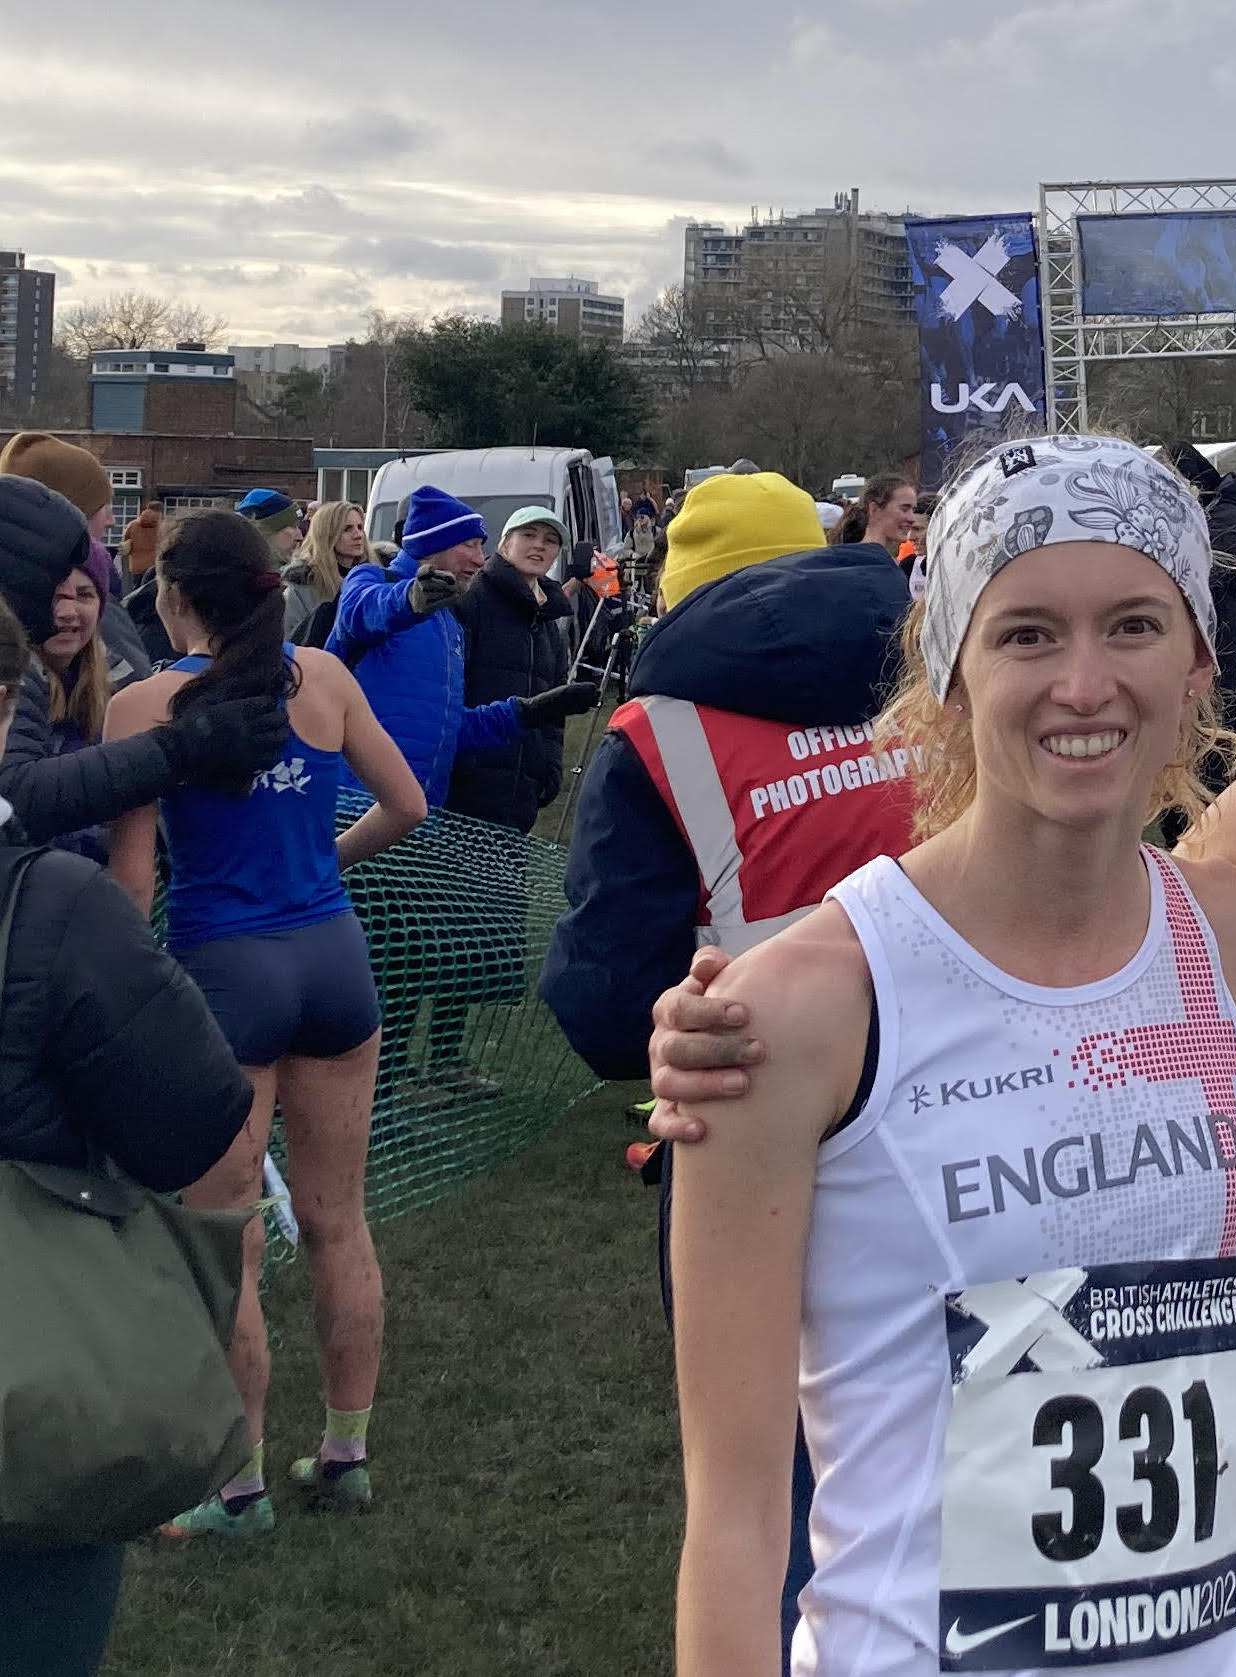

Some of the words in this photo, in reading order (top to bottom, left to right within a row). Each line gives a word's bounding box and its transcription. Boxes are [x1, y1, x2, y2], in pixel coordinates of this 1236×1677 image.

[930, 382, 1037, 413] UKA
[939, 1064, 1055, 1106] KUKRI
[1090, 1305, 1154, 1341] CROSS
[1031, 1379, 1219, 1562] 331
